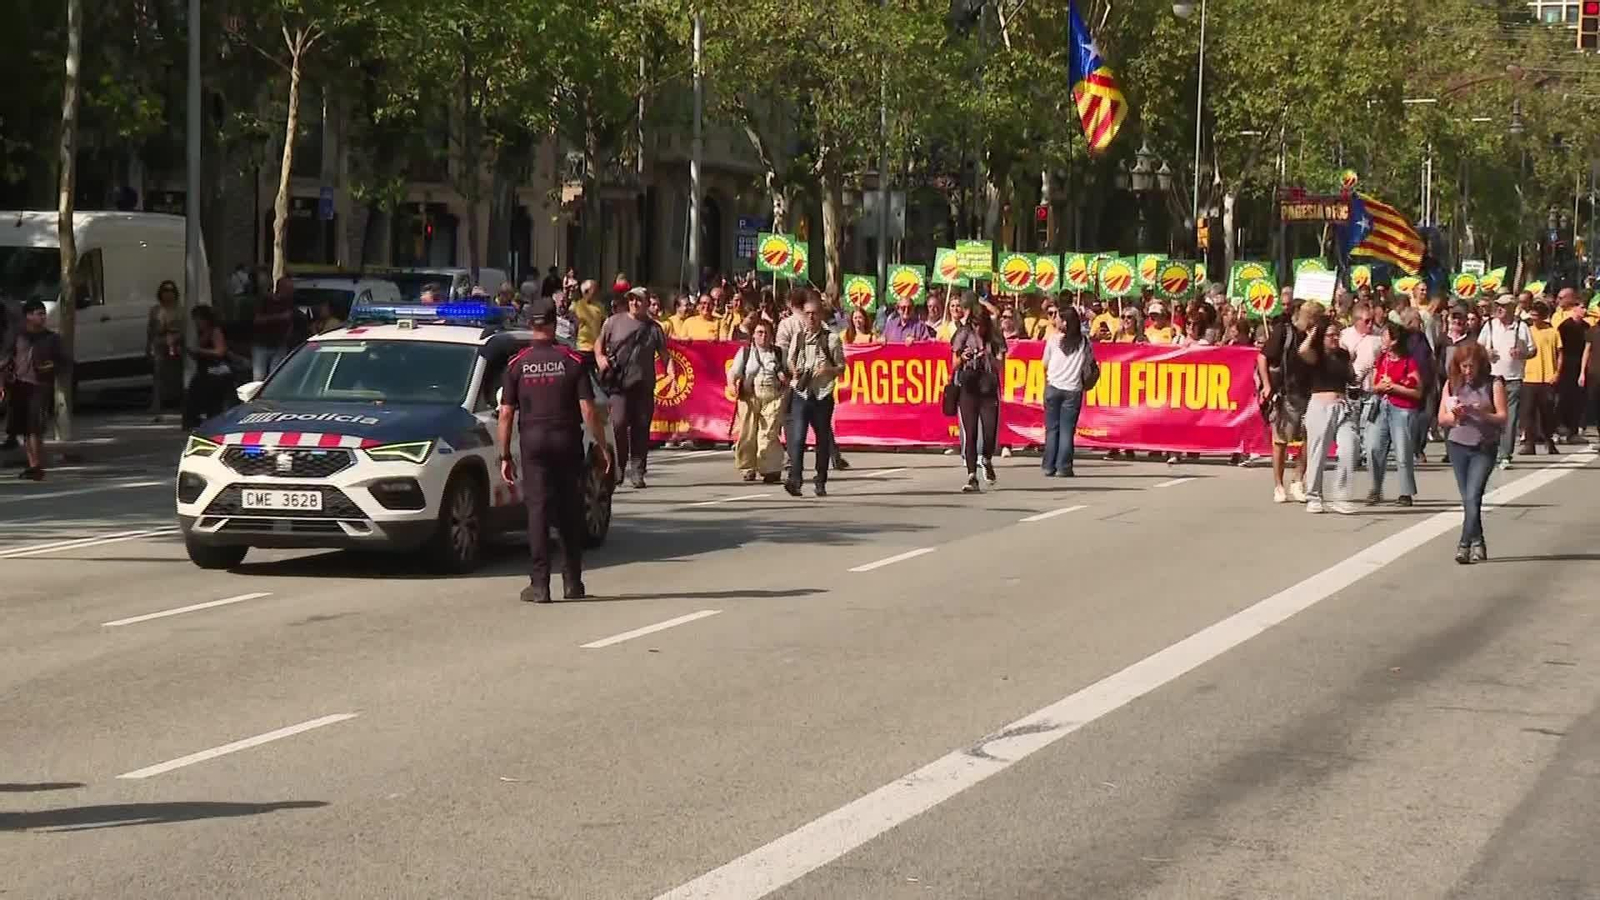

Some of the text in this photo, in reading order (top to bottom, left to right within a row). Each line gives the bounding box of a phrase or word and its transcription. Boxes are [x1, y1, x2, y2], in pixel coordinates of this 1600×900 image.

[523, 361, 566, 373] POLICIA
[833, 359, 949, 404] PAGESIA
[1004, 359, 1046, 404] PA
[1130, 362, 1237, 410] FUTUR.
[274, 412, 379, 425] policia
[247, 492, 318, 508] CME 3628
